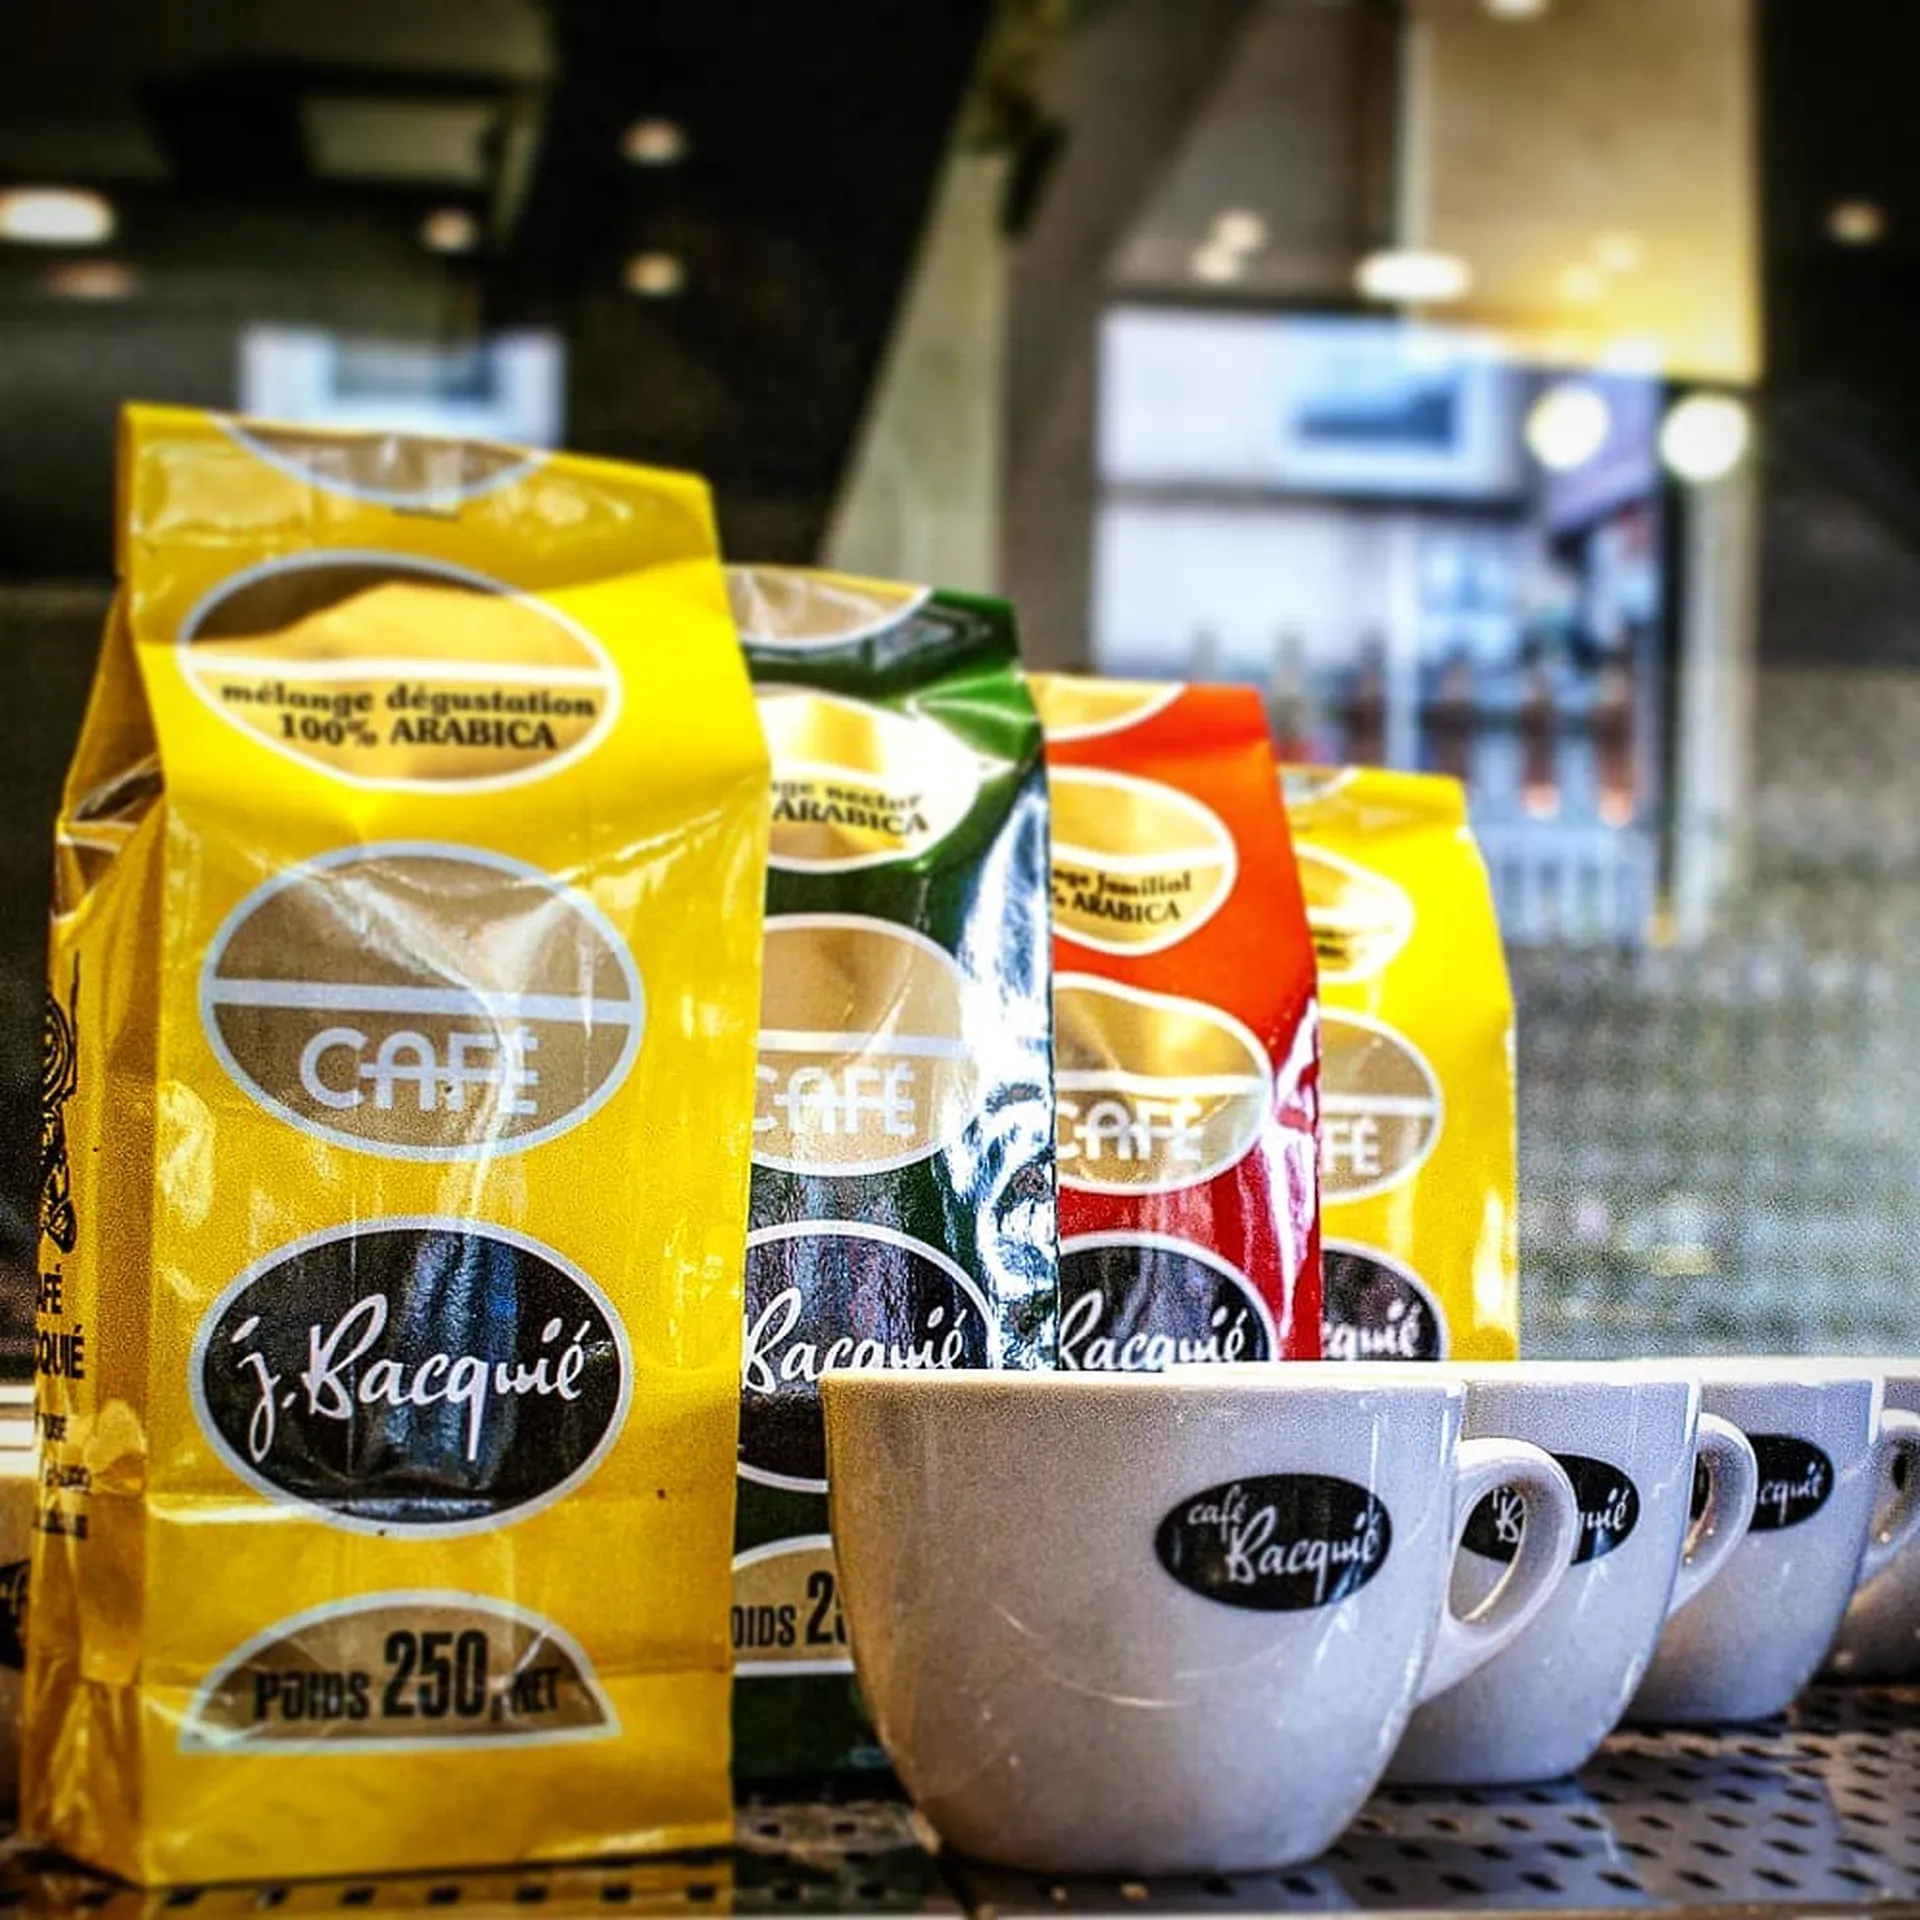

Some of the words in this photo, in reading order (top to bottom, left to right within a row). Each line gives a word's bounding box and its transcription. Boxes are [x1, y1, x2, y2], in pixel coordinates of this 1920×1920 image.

[221, 682, 375, 718] mélange
[385, 682, 597, 718] dégustation
[279, 712, 379, 748] 100%
[390, 716, 558, 751] ARABICA
[772, 798, 929, 837] ARABICA
[1071, 890, 1182, 925] ARABICA
[300, 1026, 539, 1115] CAFÉ
[752, 1060, 915, 1136] CAFÉ
[1187, 1484, 1249, 1544] café
[252, 1669, 371, 1721] POIDS
